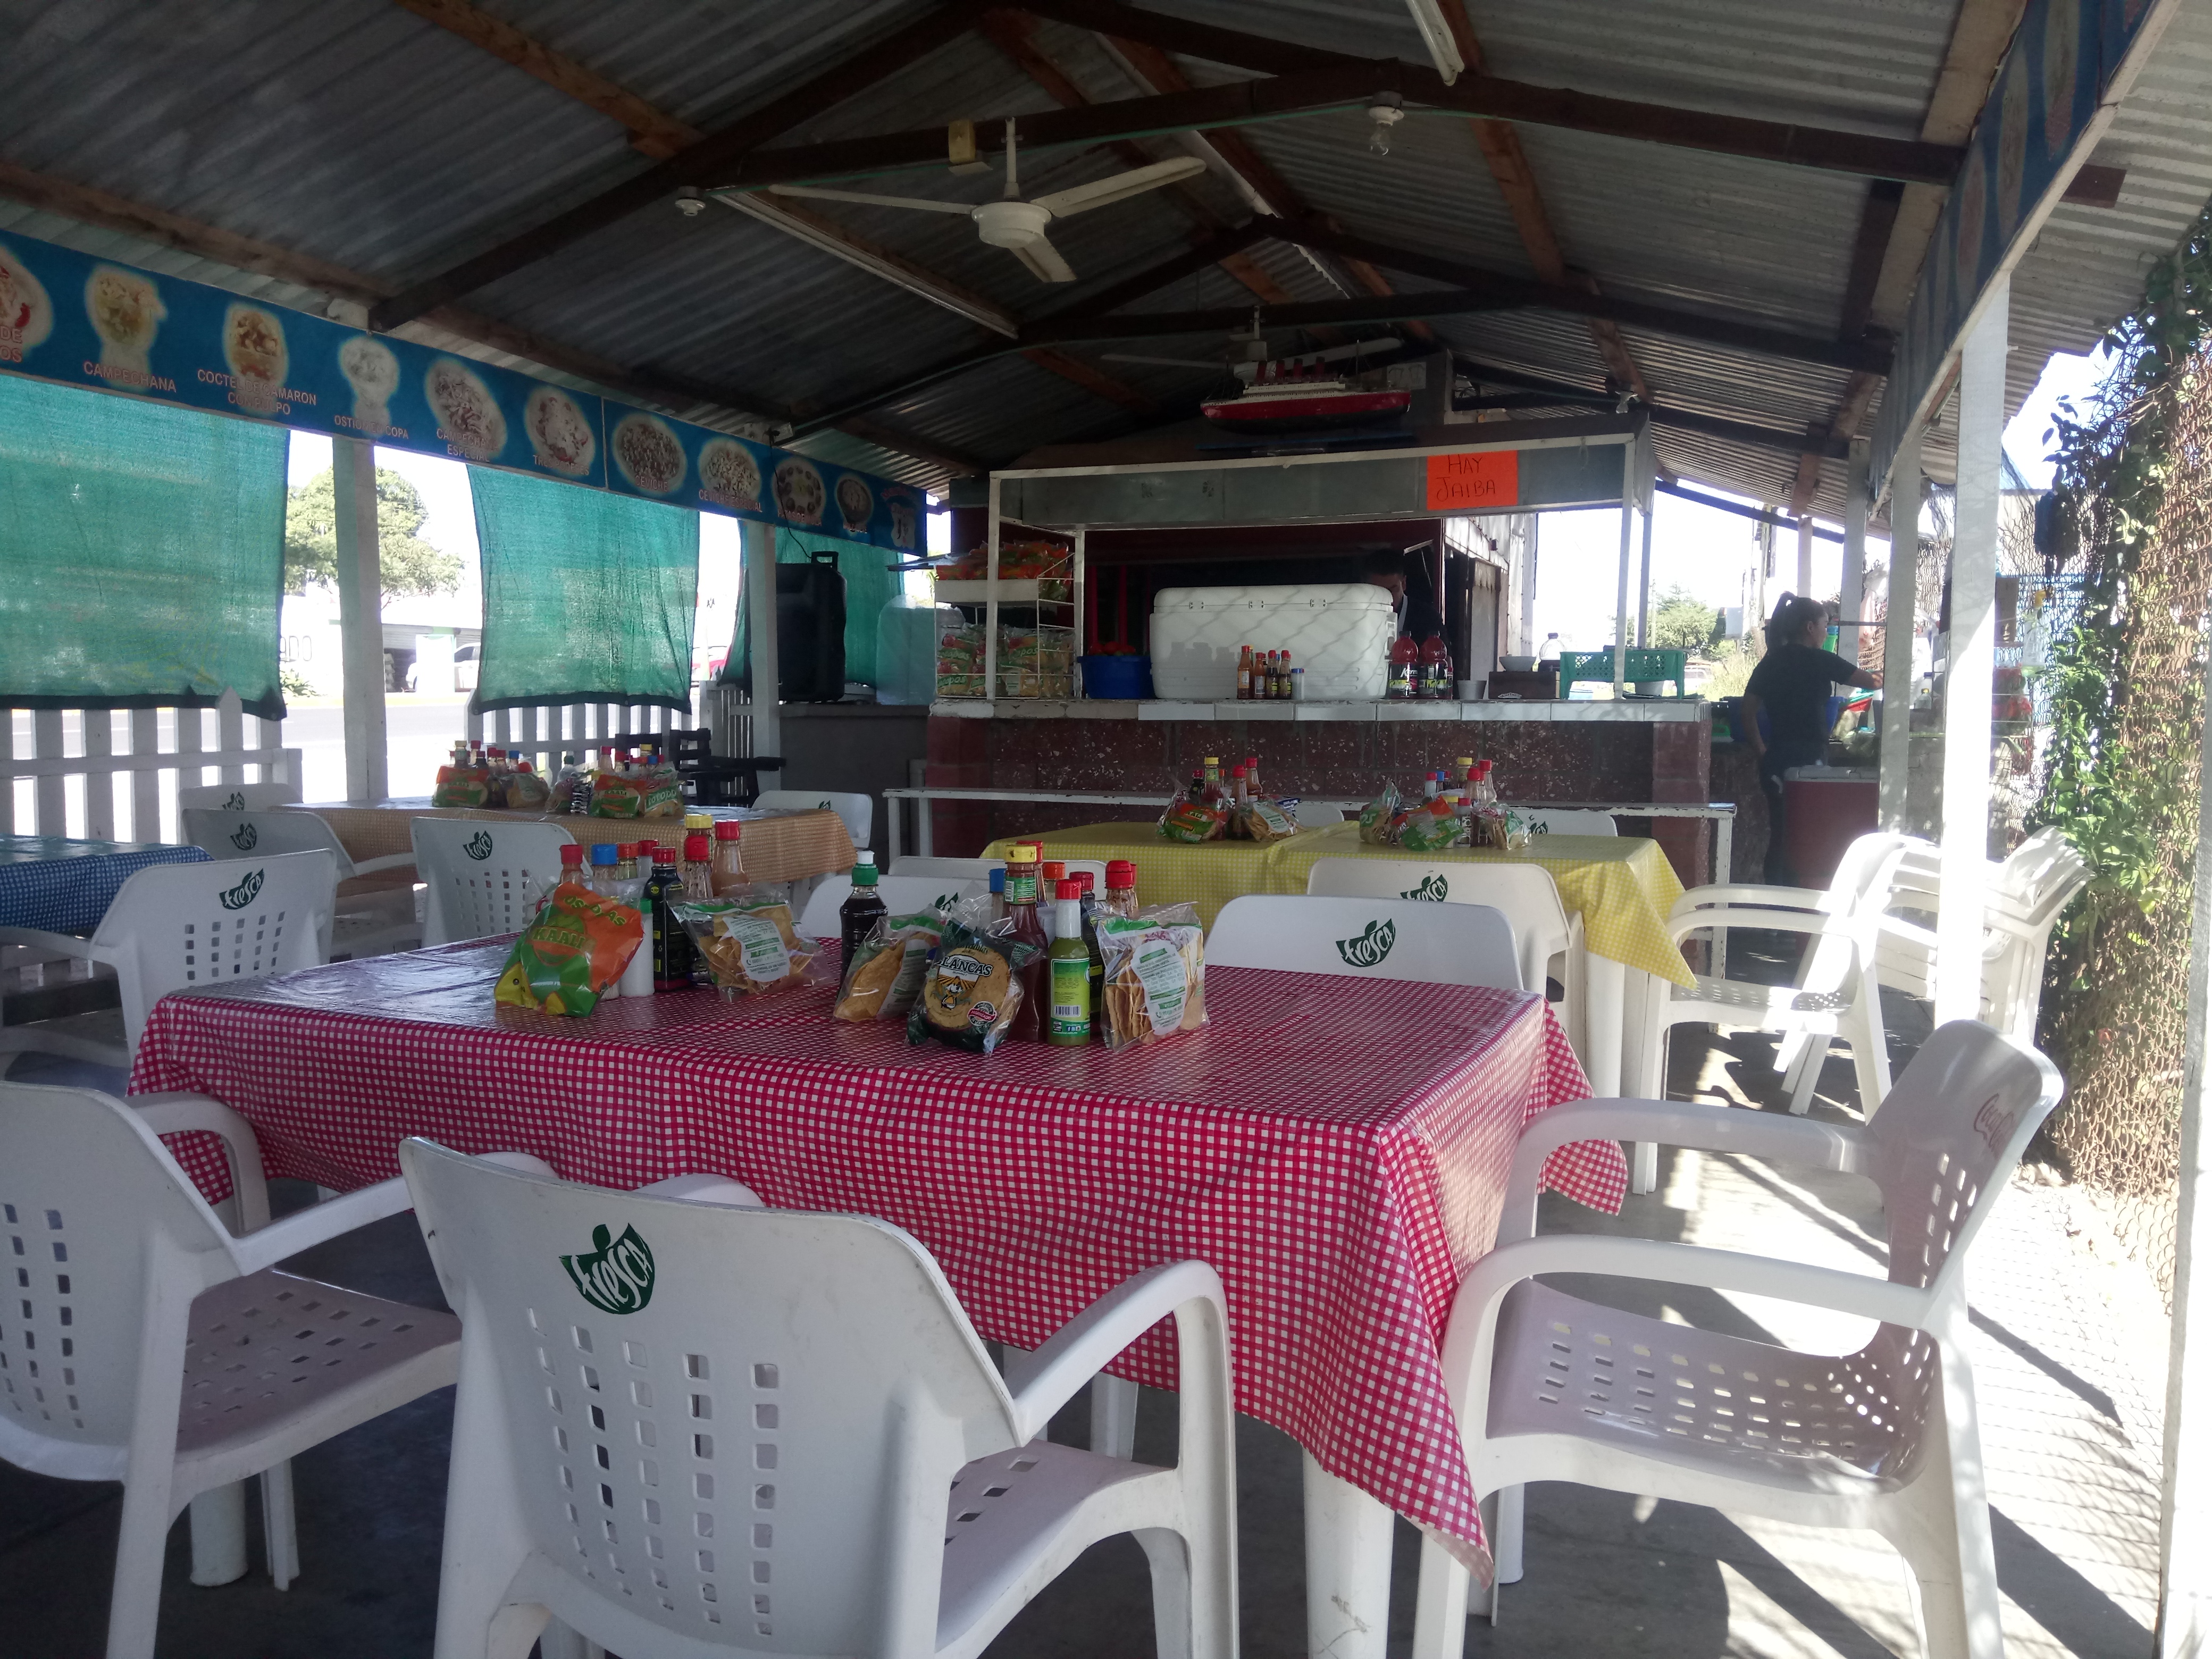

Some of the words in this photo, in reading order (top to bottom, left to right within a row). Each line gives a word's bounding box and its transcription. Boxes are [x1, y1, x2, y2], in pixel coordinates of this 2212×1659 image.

[83, 360, 177, 393] CAMPECHANA
[197, 368, 242, 390] COCTEL
[245, 379, 260, 394] DE
[262, 383, 316, 406] CAMARON
[228, 391, 252, 407] CON
[255, 397, 291, 415] PULPO
[334, 414, 370, 432] OSTION
[371, 422, 383, 434] EN
[385, 425, 409, 440] COPA
[436, 428, 500, 449] CAMPECHANA
[447, 443, 490, 463] ESPECIAL
[532, 455, 554, 468] TRES
[555, 459, 590, 476] PODERES
[1448, 454, 1483, 475] HAY
[635, 475, 669, 492] CEVICHE
[1436, 476, 1496, 502] JAIBA
[699, 489, 730, 506] CEVICHE
[731, 496, 763, 513] ESPECIAL
[532, 928, 585, 949] KAALI
[937, 956, 994, 977] LANCAS
